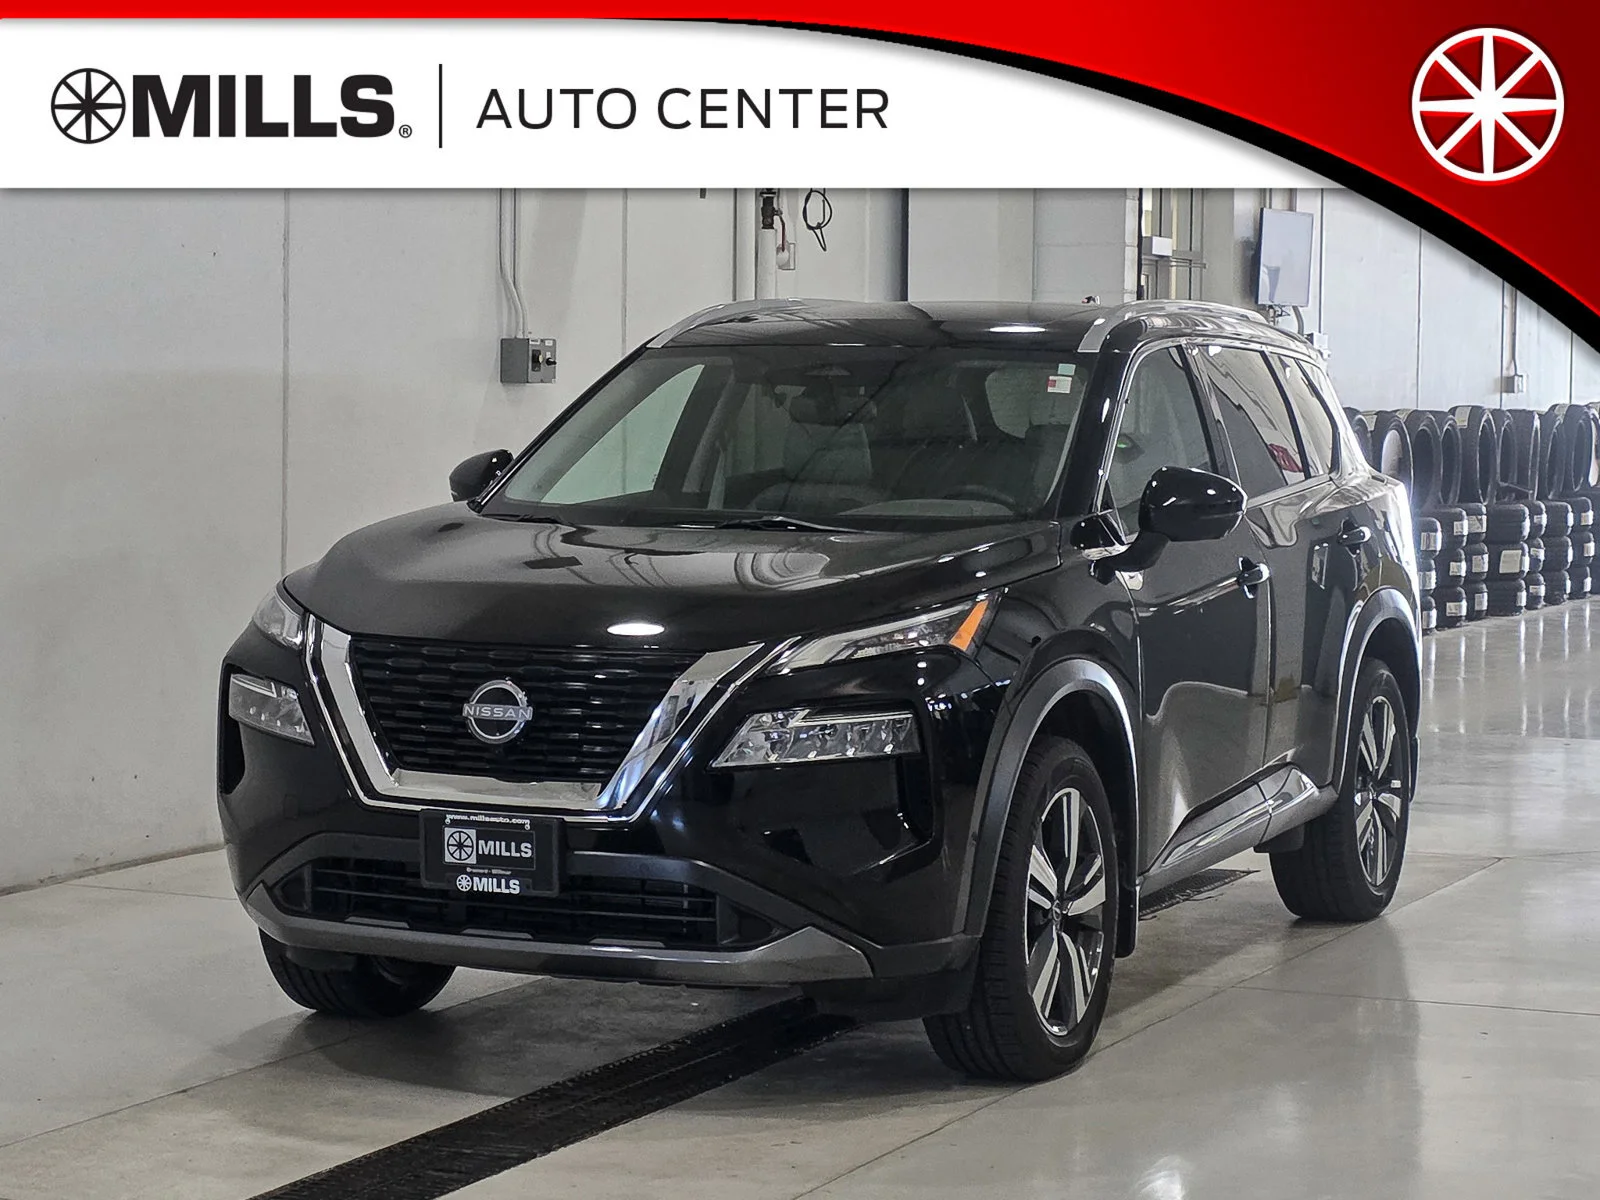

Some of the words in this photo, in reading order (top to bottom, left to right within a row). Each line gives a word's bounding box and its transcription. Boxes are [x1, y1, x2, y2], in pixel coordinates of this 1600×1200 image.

[464, 705, 531, 719] NISSAN
[478, 840, 532, 858] MILLS
[473, 876, 520, 894] MILLS
